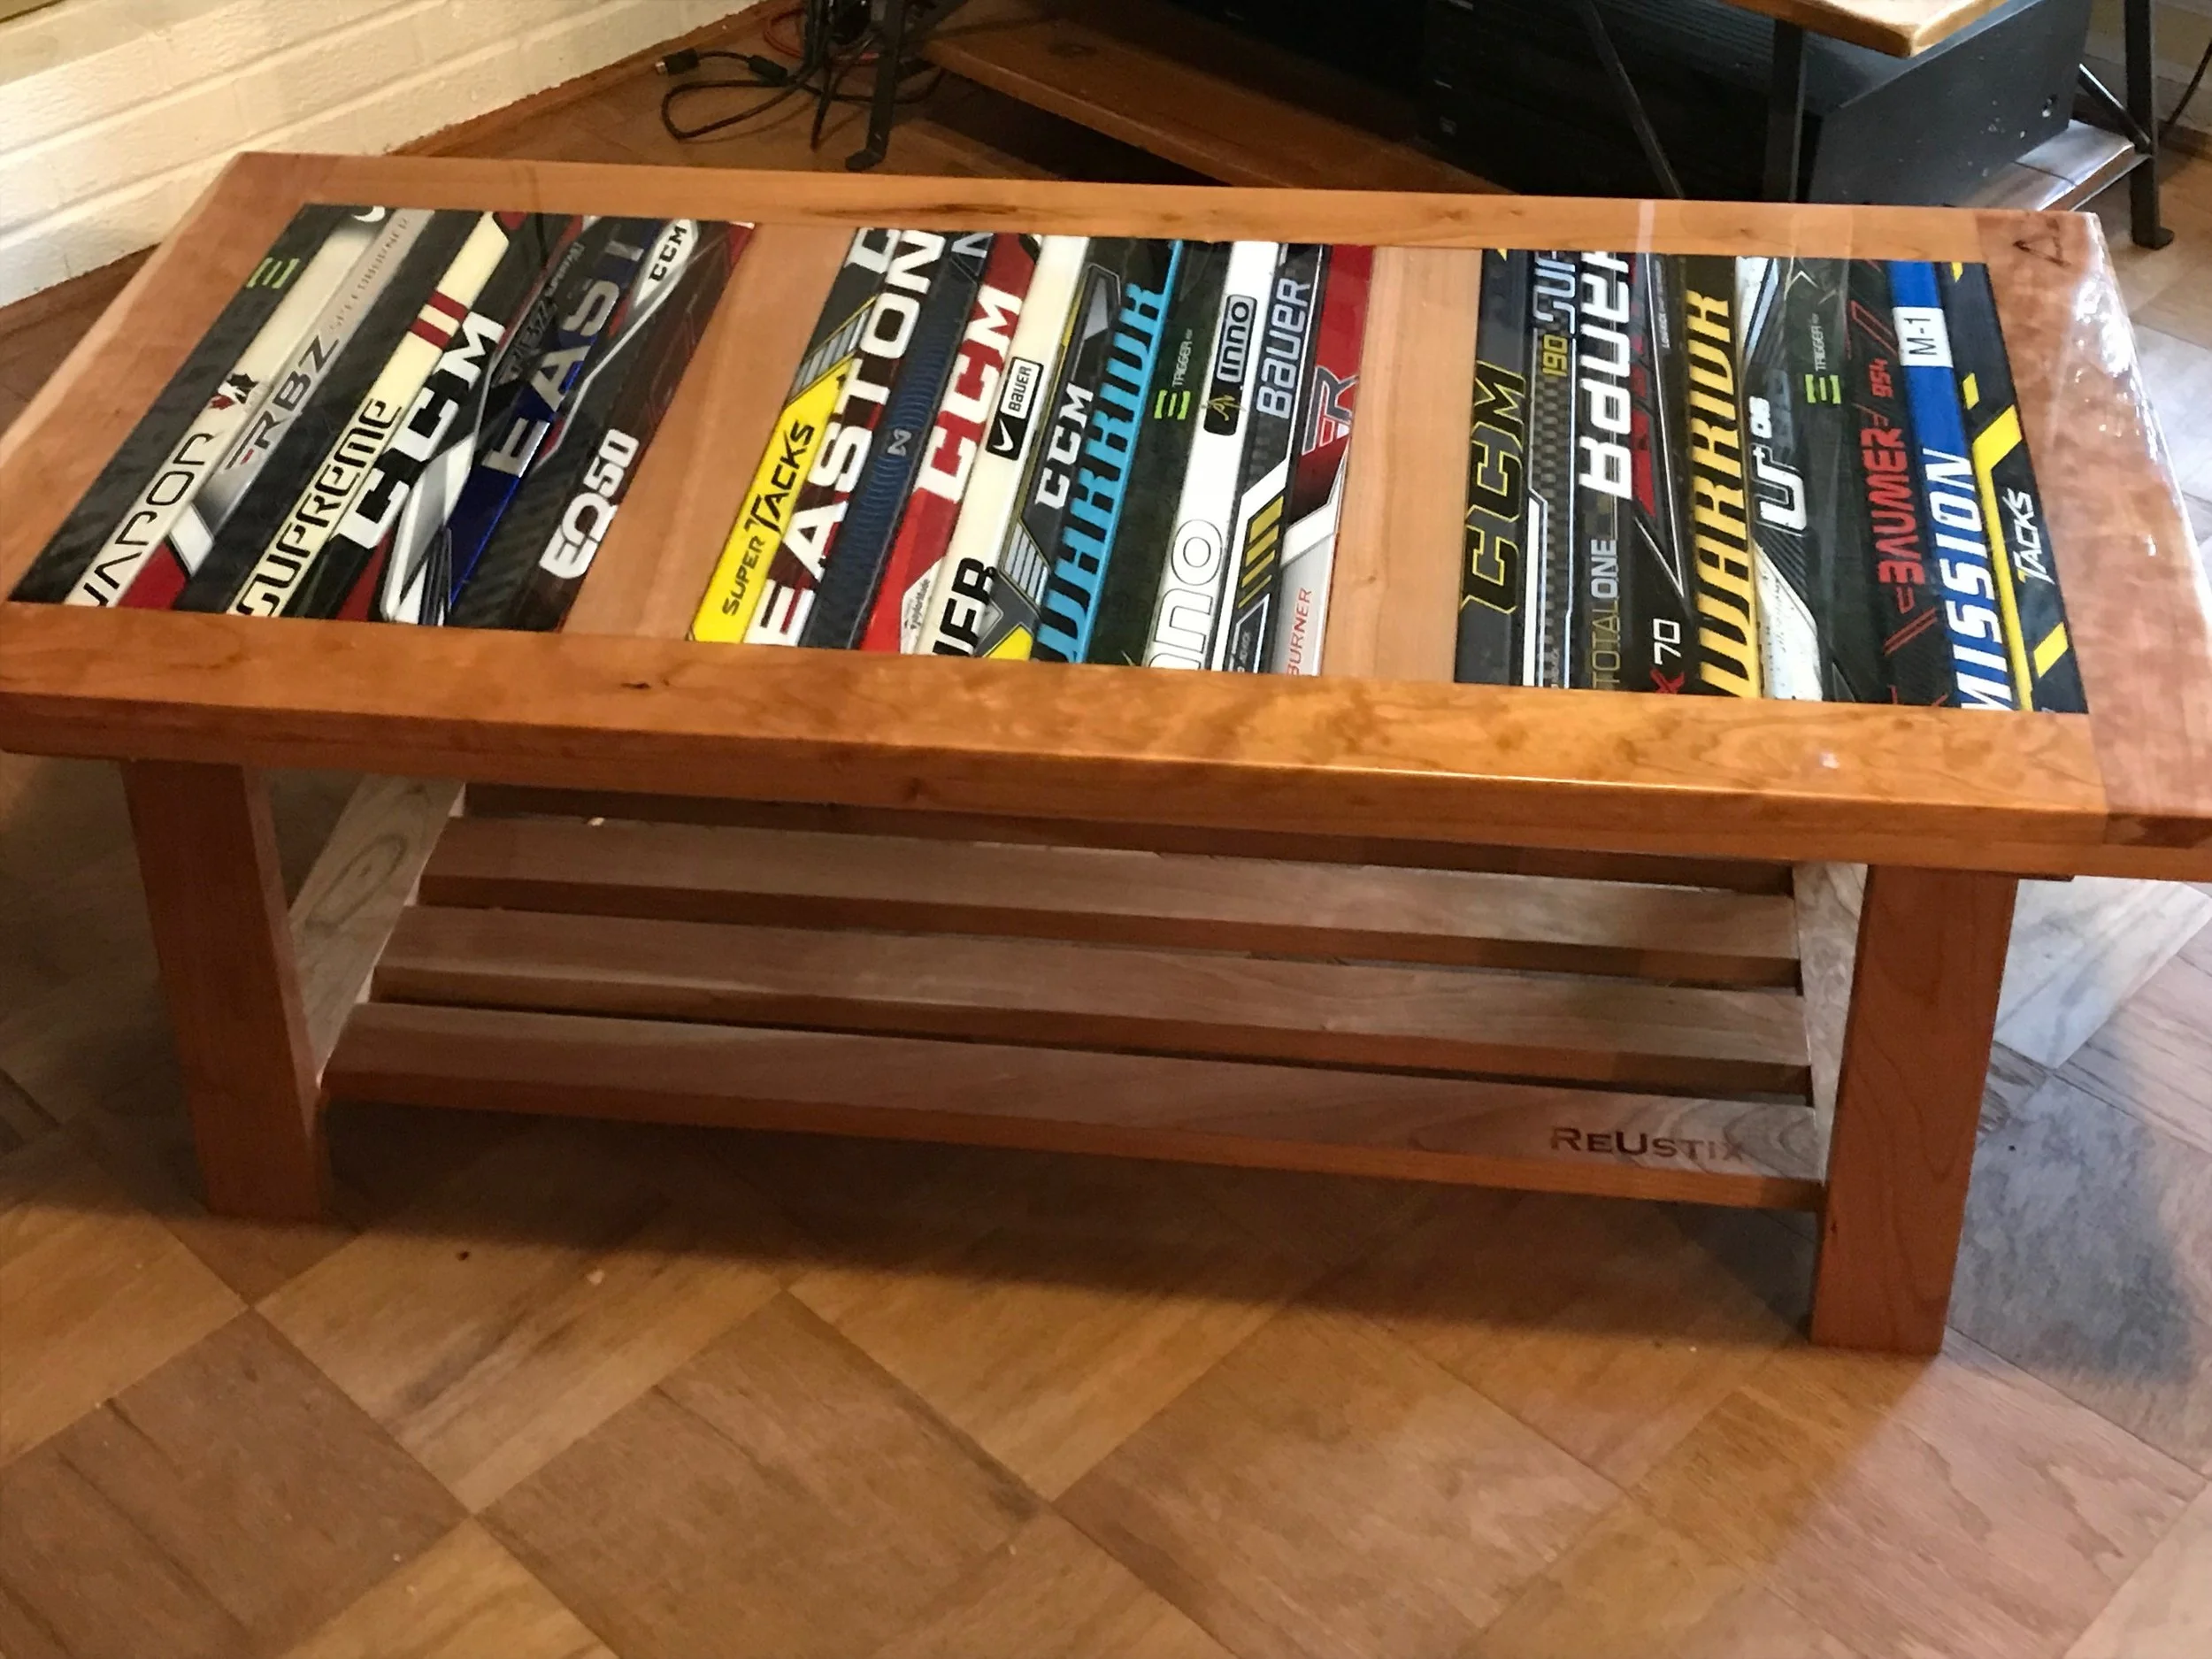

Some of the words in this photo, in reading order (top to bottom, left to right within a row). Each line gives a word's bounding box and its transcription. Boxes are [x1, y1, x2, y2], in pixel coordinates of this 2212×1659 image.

[649, 224, 688, 282] CCM
[225, 333, 341, 470] RBZ
[913, 285, 1025, 504] CCM
[1009, 365, 1033, 413] BAUER
[1172, 340, 1194, 388] TRIGGER
[1256, 277, 1312, 420] BAUER
[1542, 334, 1568, 377] 190
[1815, 324, 1827, 373] TRIGGER
[1903, 317, 1939, 356] M-1
[334, 311, 506, 549] CCM
[743, 228, 946, 648] EASTON
[1034, 382, 1094, 511] CCM
[1035, 281, 1166, 664] WARRIOR
[1460, 360, 1526, 615] CCM
[1686, 288, 1755, 698] WARRIOR
[236, 398, 402, 617] SUPREME
[540, 428, 640, 580] EQ50
[721, 535, 765, 617] SUPER
[745, 420, 816, 534] TACKS
[2002, 488, 2055, 585] TACKS
[1287, 588, 1313, 676] BURNER
[1651, 618, 1682, 665] 70
[1922, 448, 2015, 711] MISSION
